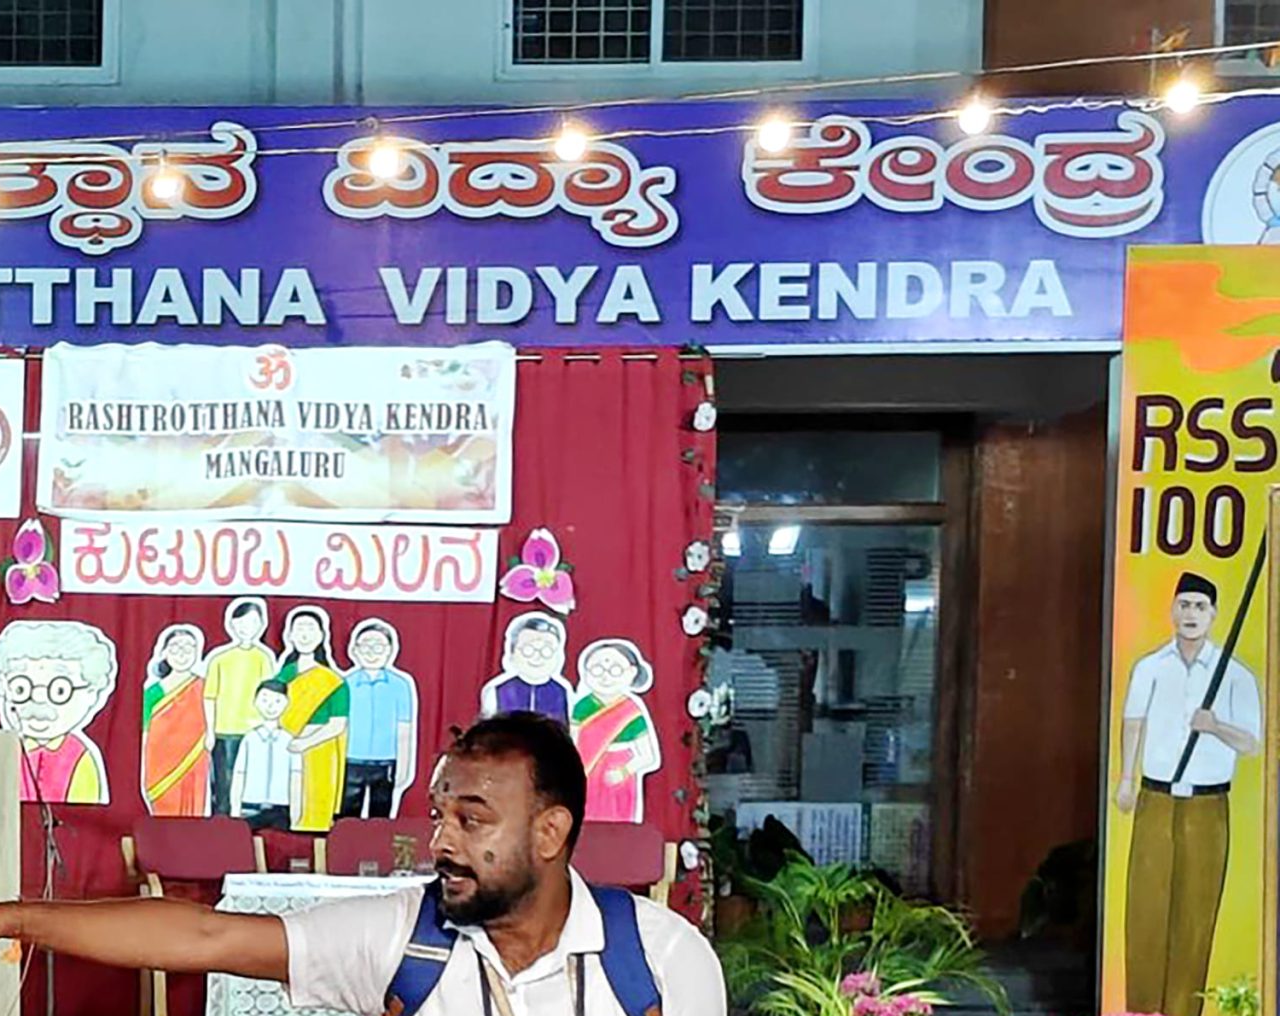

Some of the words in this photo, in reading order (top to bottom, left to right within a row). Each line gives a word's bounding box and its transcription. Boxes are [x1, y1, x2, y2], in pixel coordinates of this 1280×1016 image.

[744, 113, 1165, 239] ಕೇಂದ್ರ
[381, 264, 662, 326] VIDYA
[689, 260, 1073, 322] KENDRA
[68, 401, 286, 431] RASHTROTTHANA
[298, 402, 374, 430] VIDYA
[386, 403, 488, 430] KENDRA
[1131, 394, 1278, 473] RSS
[205, 450, 346, 479] MANGALURU
[1131, 486, 1245, 556] 100
[73, 523, 291, 586] ಕುಟುಂಬ
[314, 532, 483, 593] ಮಿಲನ
